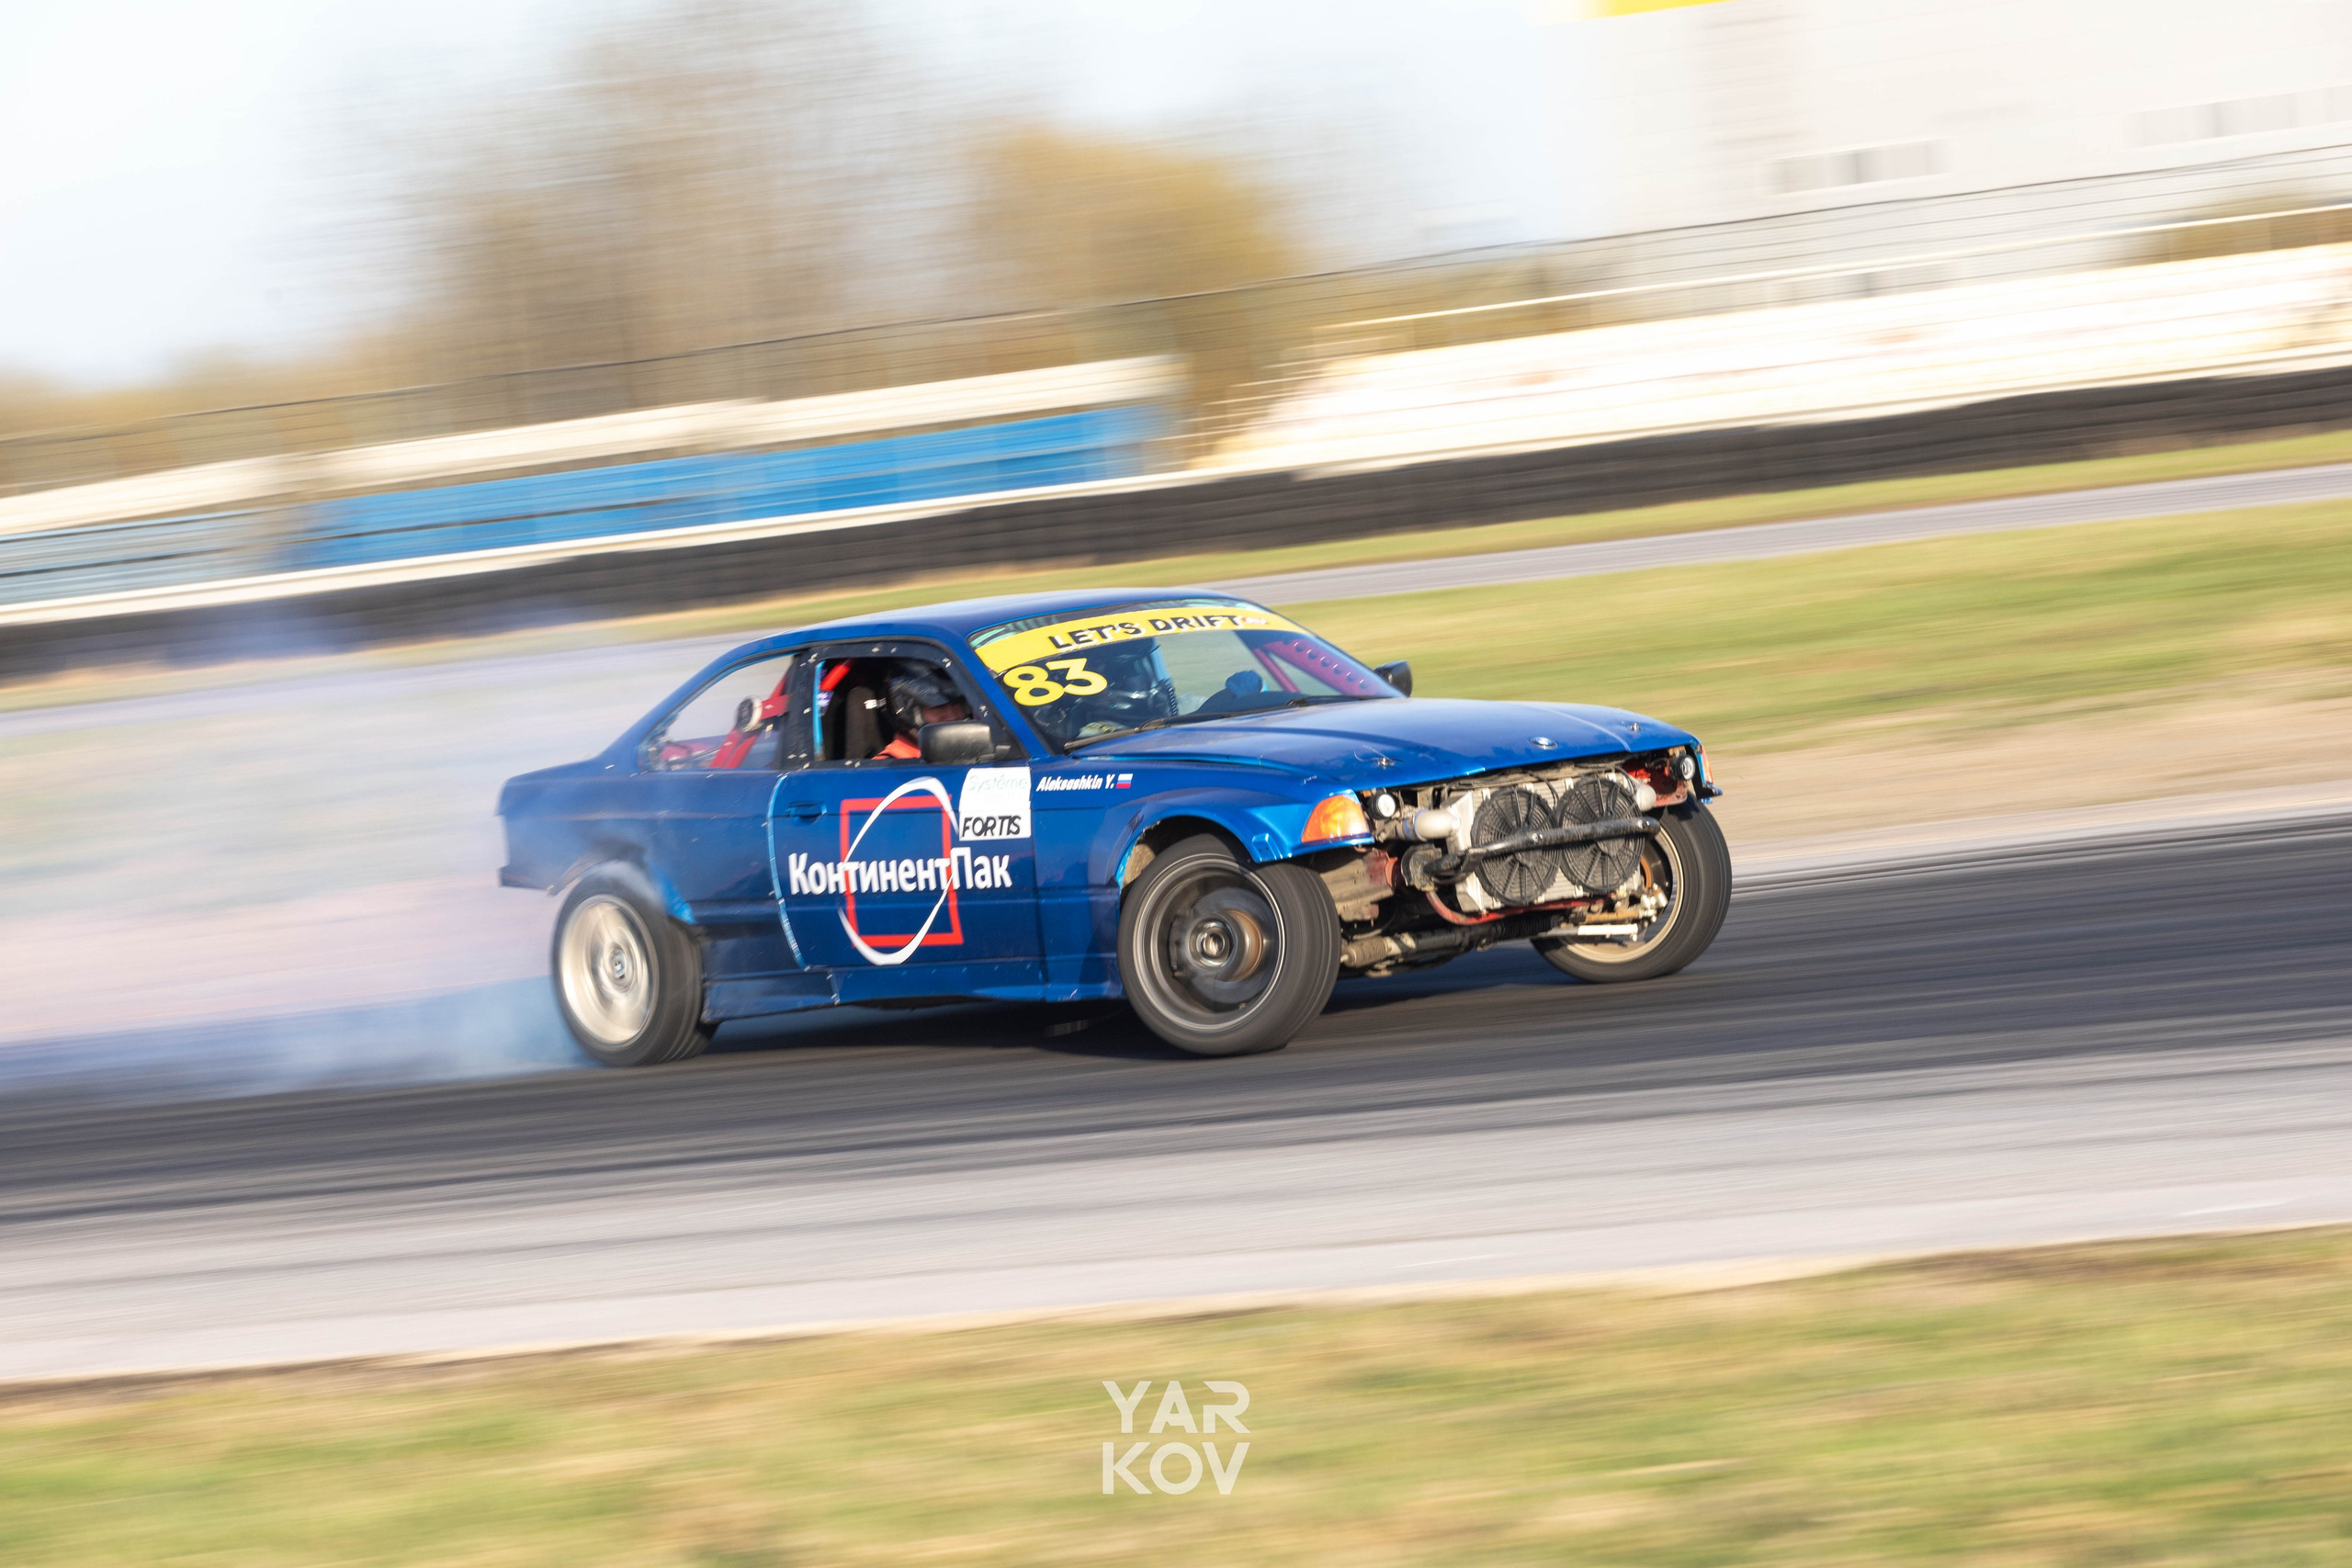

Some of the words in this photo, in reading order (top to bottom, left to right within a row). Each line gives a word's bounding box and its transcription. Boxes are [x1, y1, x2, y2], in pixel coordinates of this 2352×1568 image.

[1048, 621, 1146, 651] LET'S
[1148, 615, 1243, 633] DRIFT
[1003, 658, 1107, 706] 83
[1104, 773, 1115, 789] Y.
[962, 815, 1022, 838] FORTIS
[788, 847, 1012, 896] КонтинентПак
